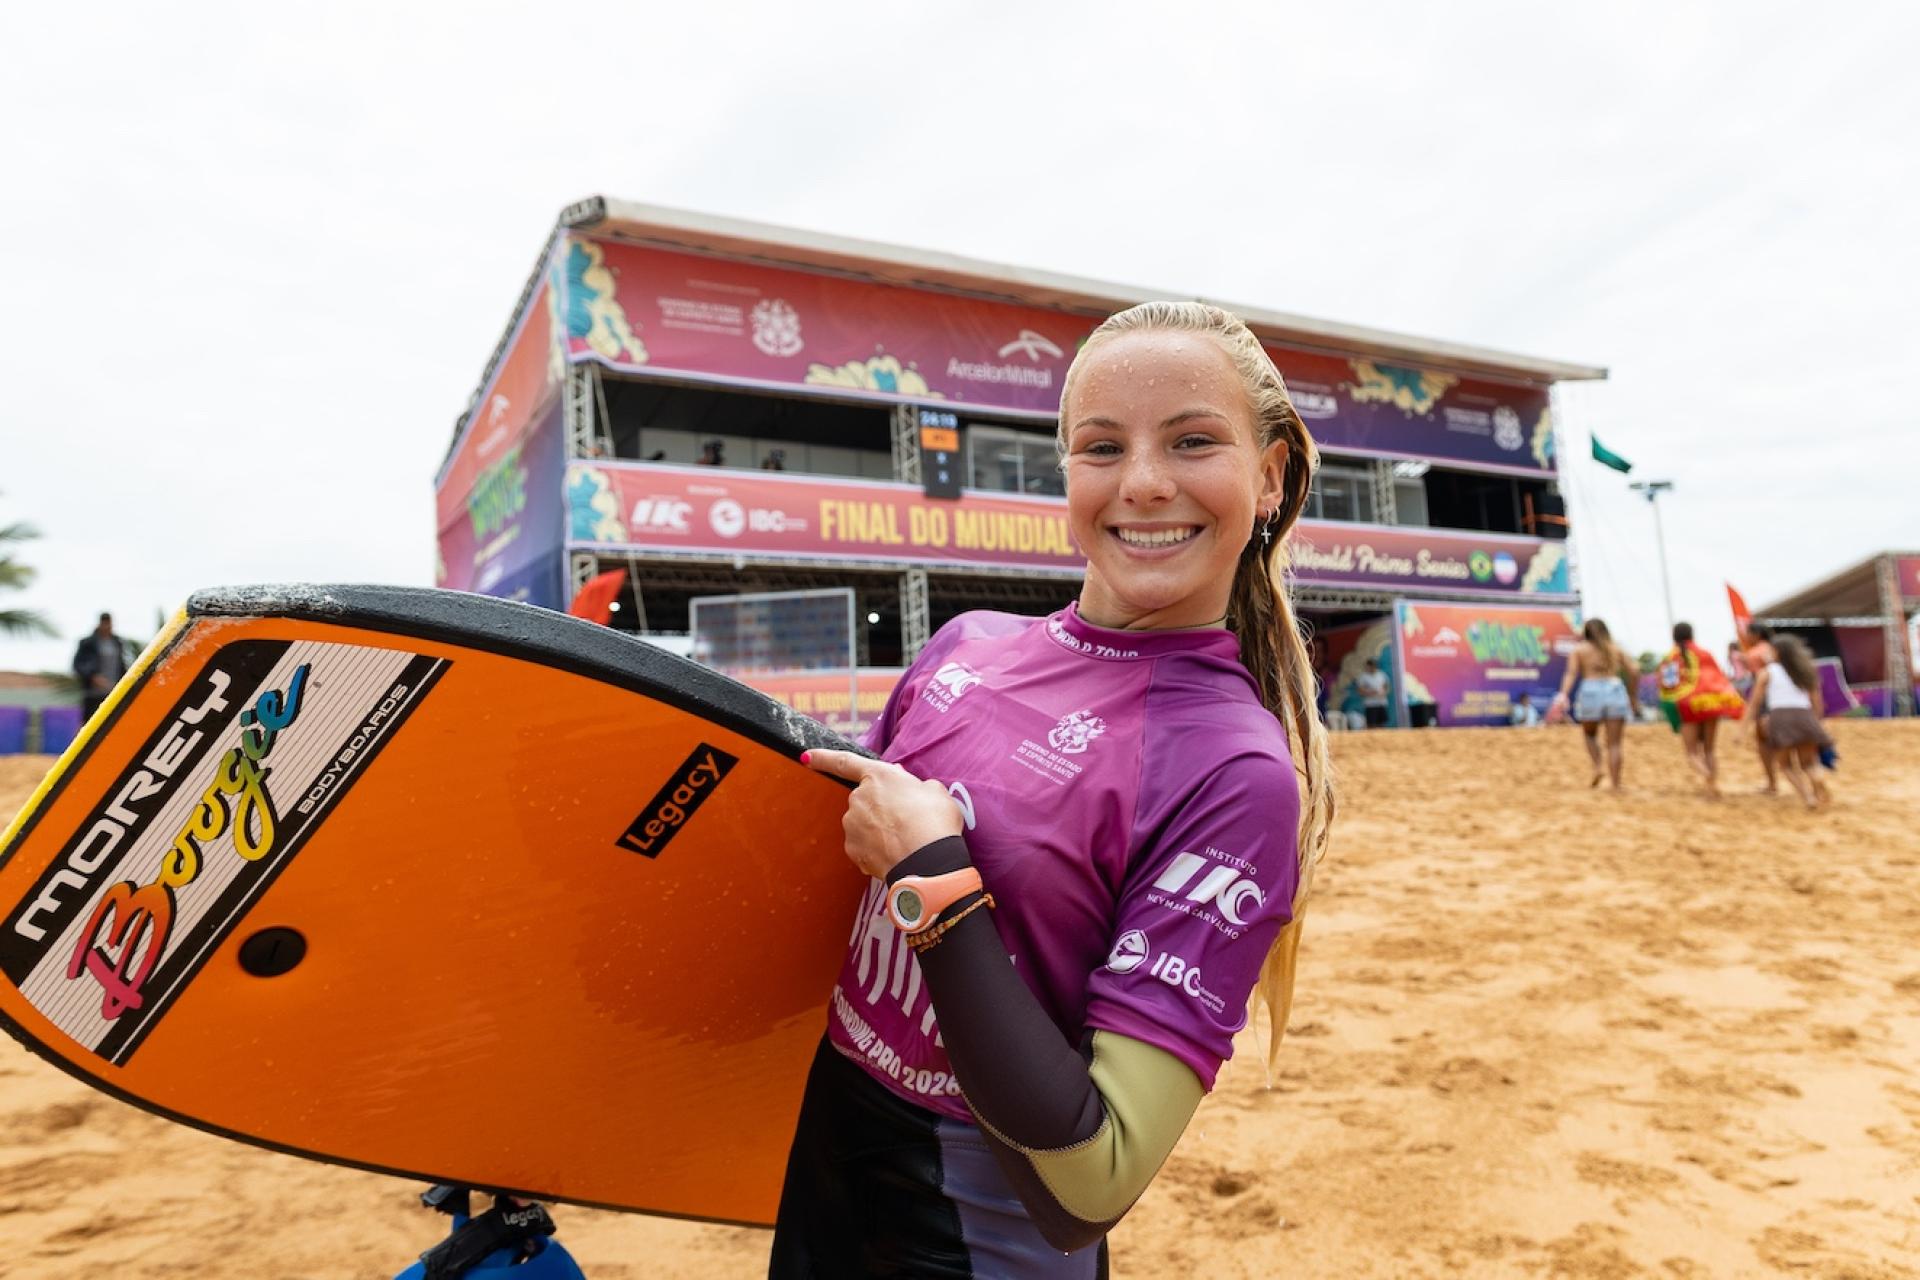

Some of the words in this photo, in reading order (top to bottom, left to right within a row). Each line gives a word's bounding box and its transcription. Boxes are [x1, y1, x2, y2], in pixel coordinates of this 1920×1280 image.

[819, 499, 905, 545] FINAL
[908, 504, 949, 547] DO
[953, 509, 1076, 556] MUNDIAL
[1355, 543, 1415, 576] Prime
[1415, 548, 1470, 580] Series
[297, 683, 410, 816] BODYBOARDS
[14, 668, 232, 942] MOREY
[625, 751, 721, 850] Legacy
[1205, 845, 1257, 876] INSTITUTO
[1150, 951, 1201, 998] IBC
[867, 1037, 902, 1080] PRO
[902, 1065, 961, 1097] 2026
